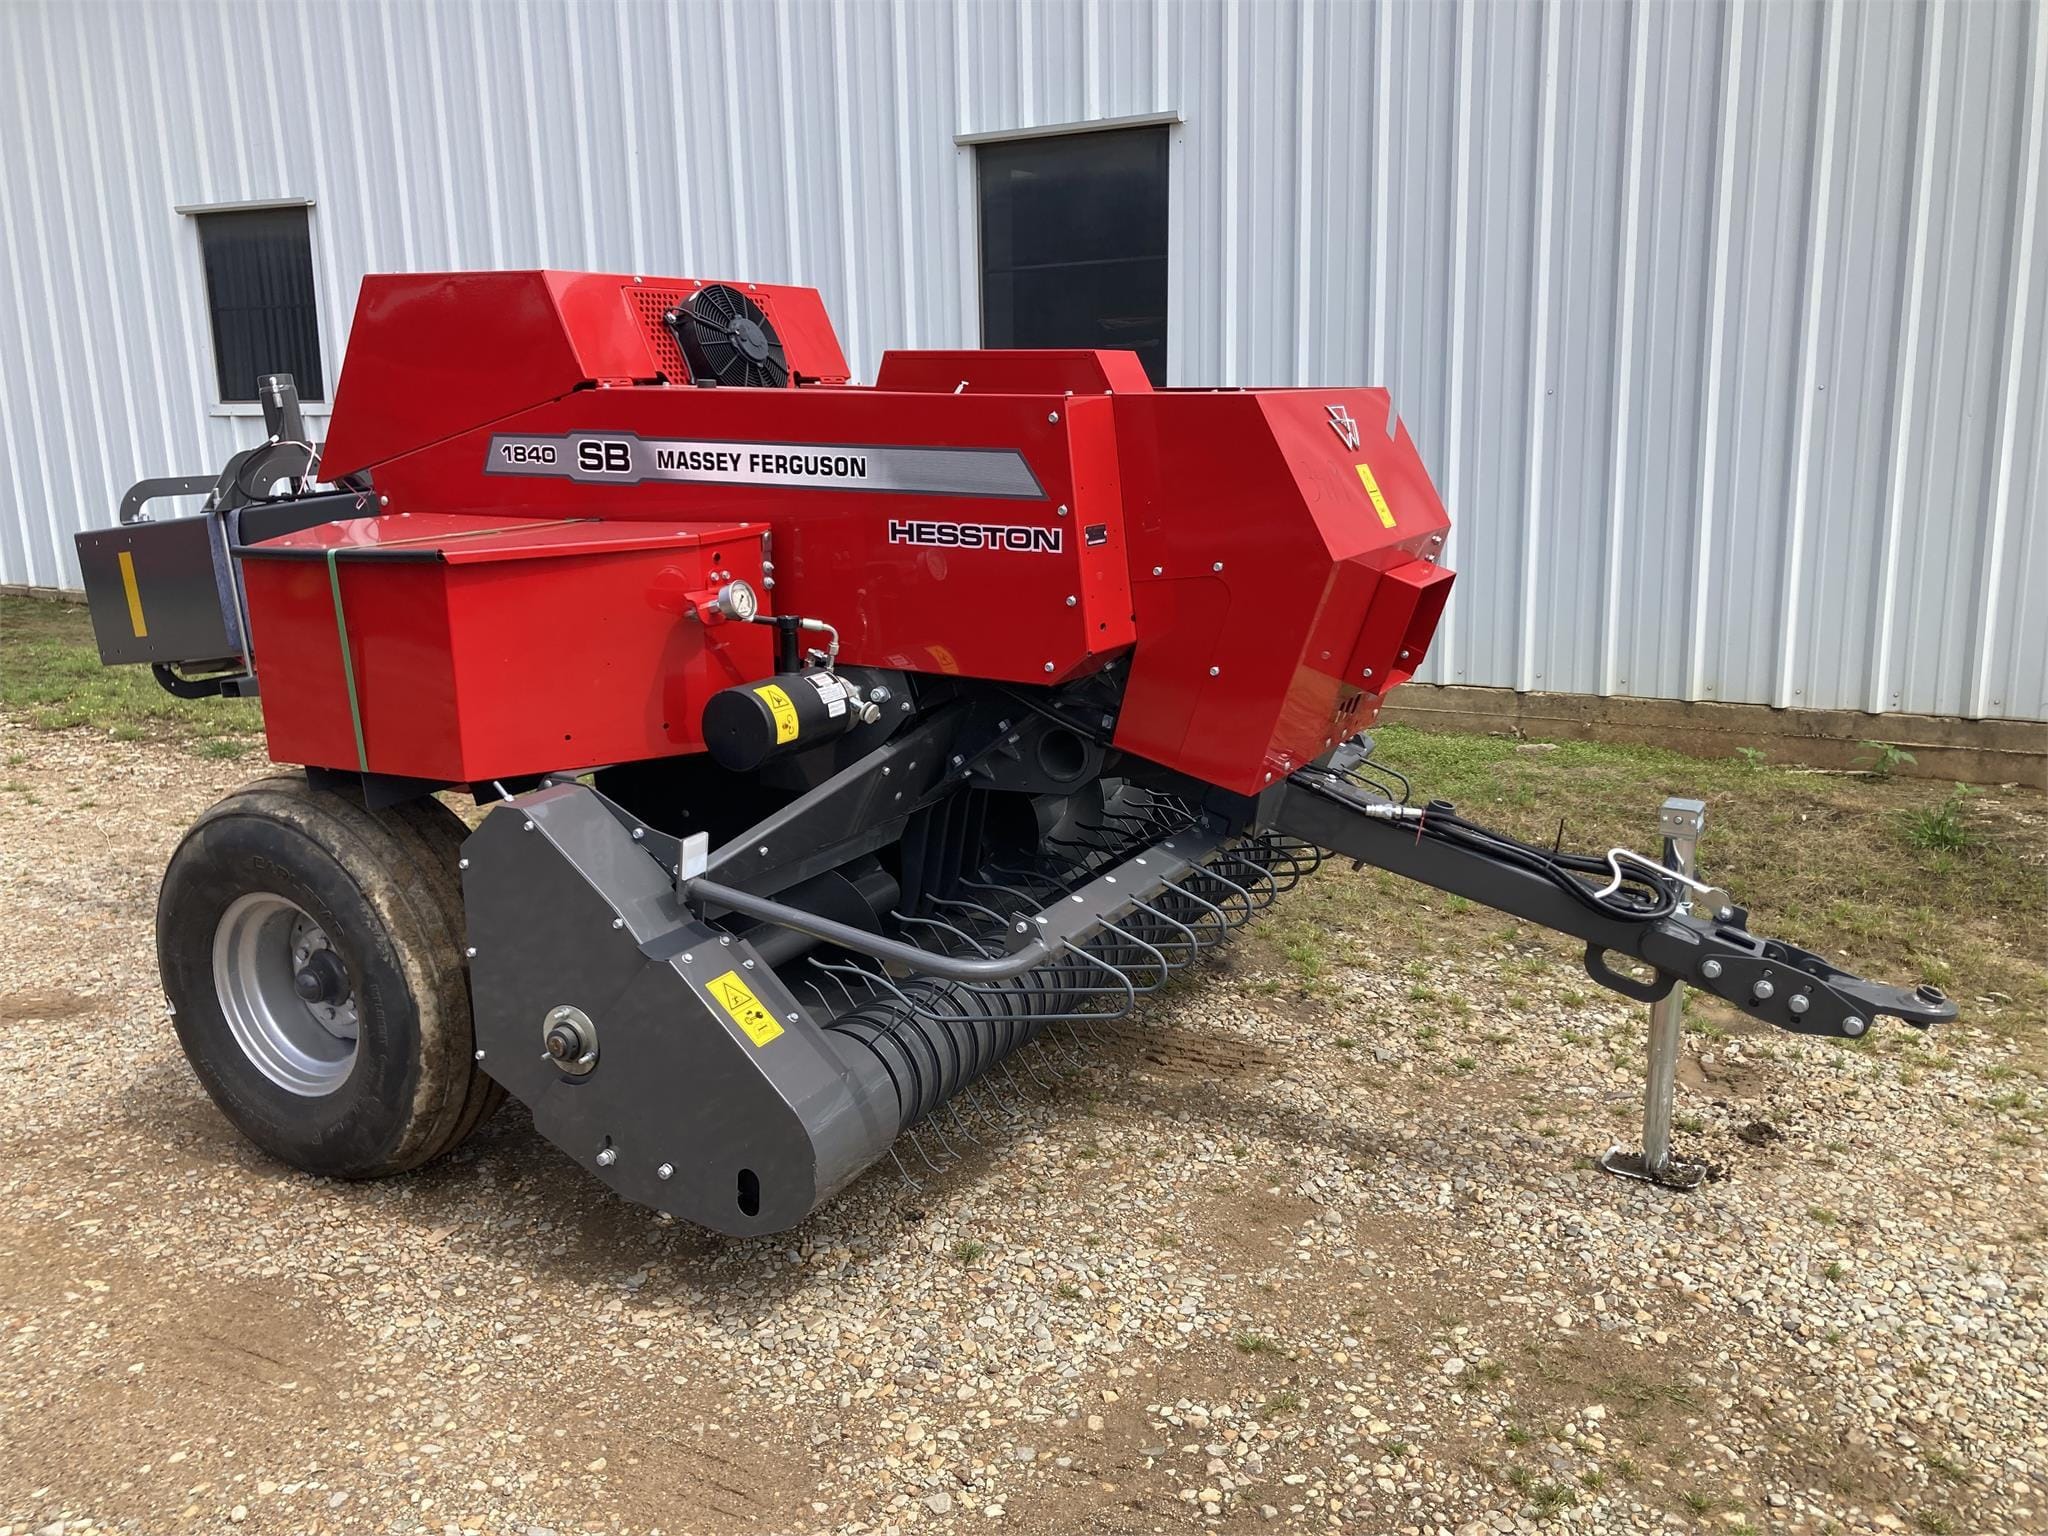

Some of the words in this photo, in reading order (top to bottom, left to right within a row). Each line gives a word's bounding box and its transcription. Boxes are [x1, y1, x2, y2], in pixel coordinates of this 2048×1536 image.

[501, 444, 556, 464] 1840
[578, 440, 632, 473] SB
[656, 449, 742, 472] MASSEY
[749, 453, 868, 478] FERGUSON
[889, 520, 1062, 553] HESSTON
